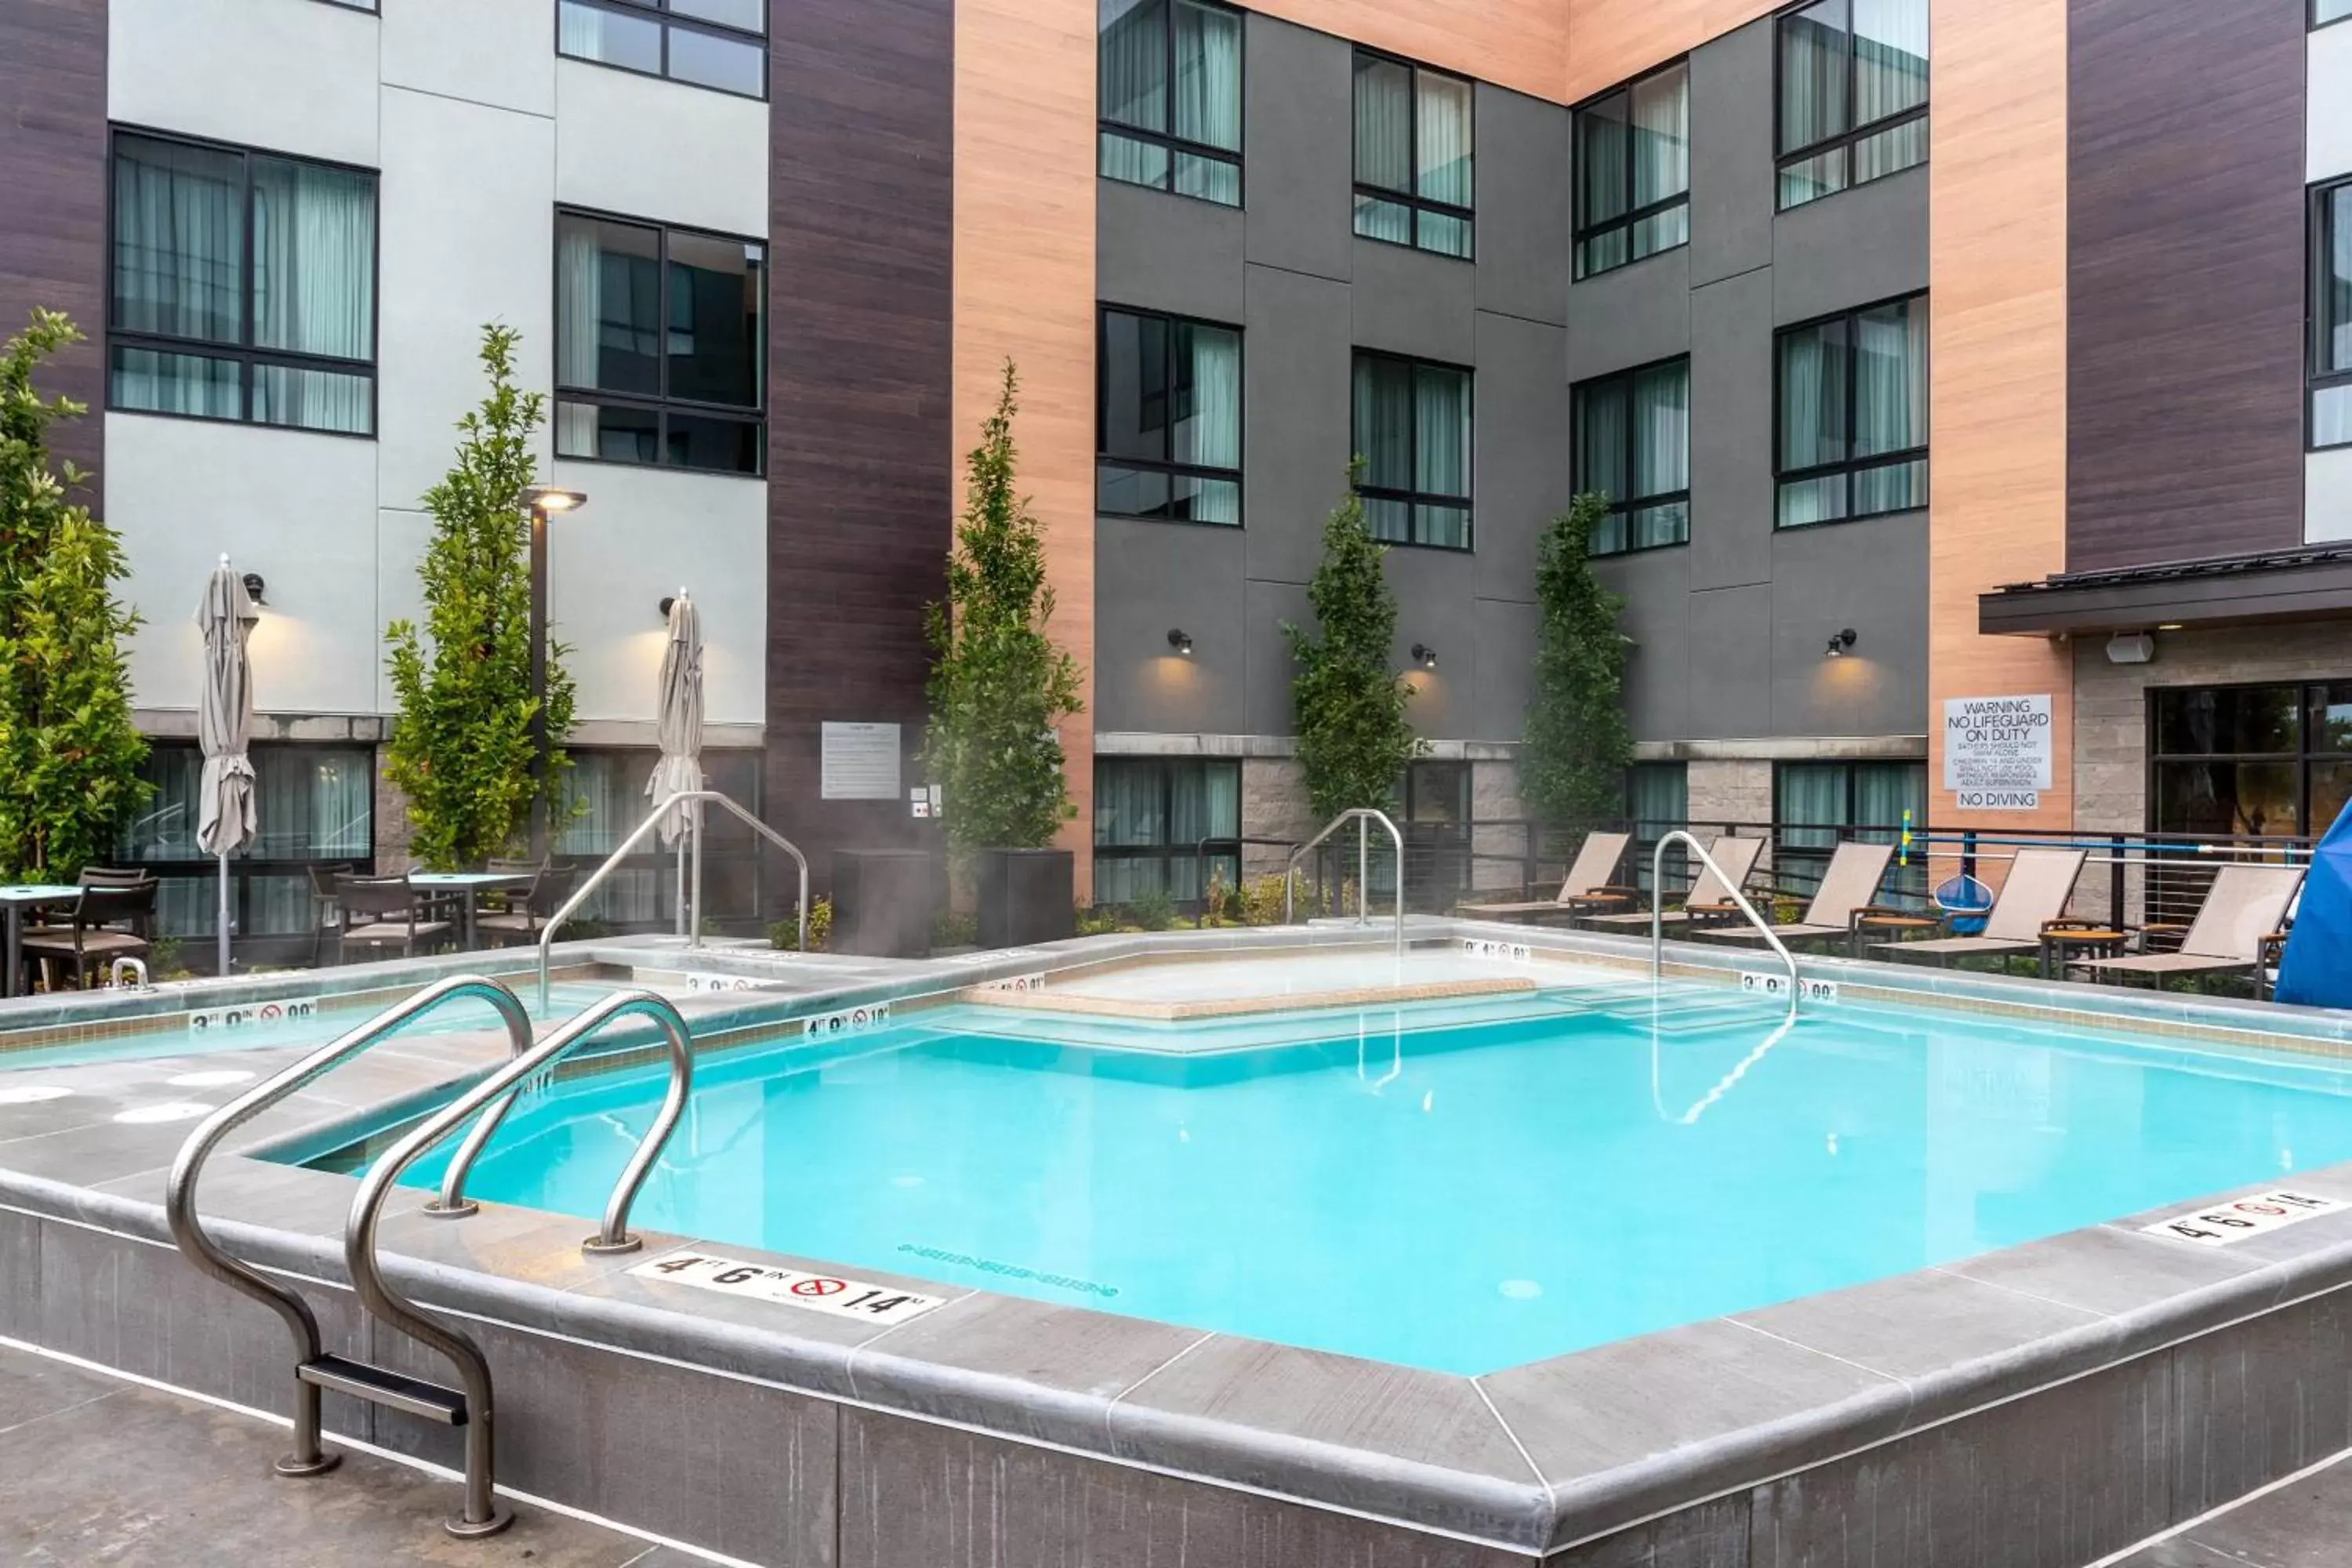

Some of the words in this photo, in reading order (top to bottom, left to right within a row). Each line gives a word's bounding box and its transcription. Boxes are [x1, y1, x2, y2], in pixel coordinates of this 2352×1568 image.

[1964, 700, 2031, 714] WARNING
[1948, 717, 1970, 728] NO
[1973, 713, 2049, 728] LIFEGUARD
[1965, 729, 1987, 742] ON
[1992, 728, 2031, 741] DUTY
[1960, 793, 1983, 806] NO
[1986, 793, 2036, 806] DIVING
[655, 1257, 705, 1274] 4
[713, 1267, 764, 1283] 6
